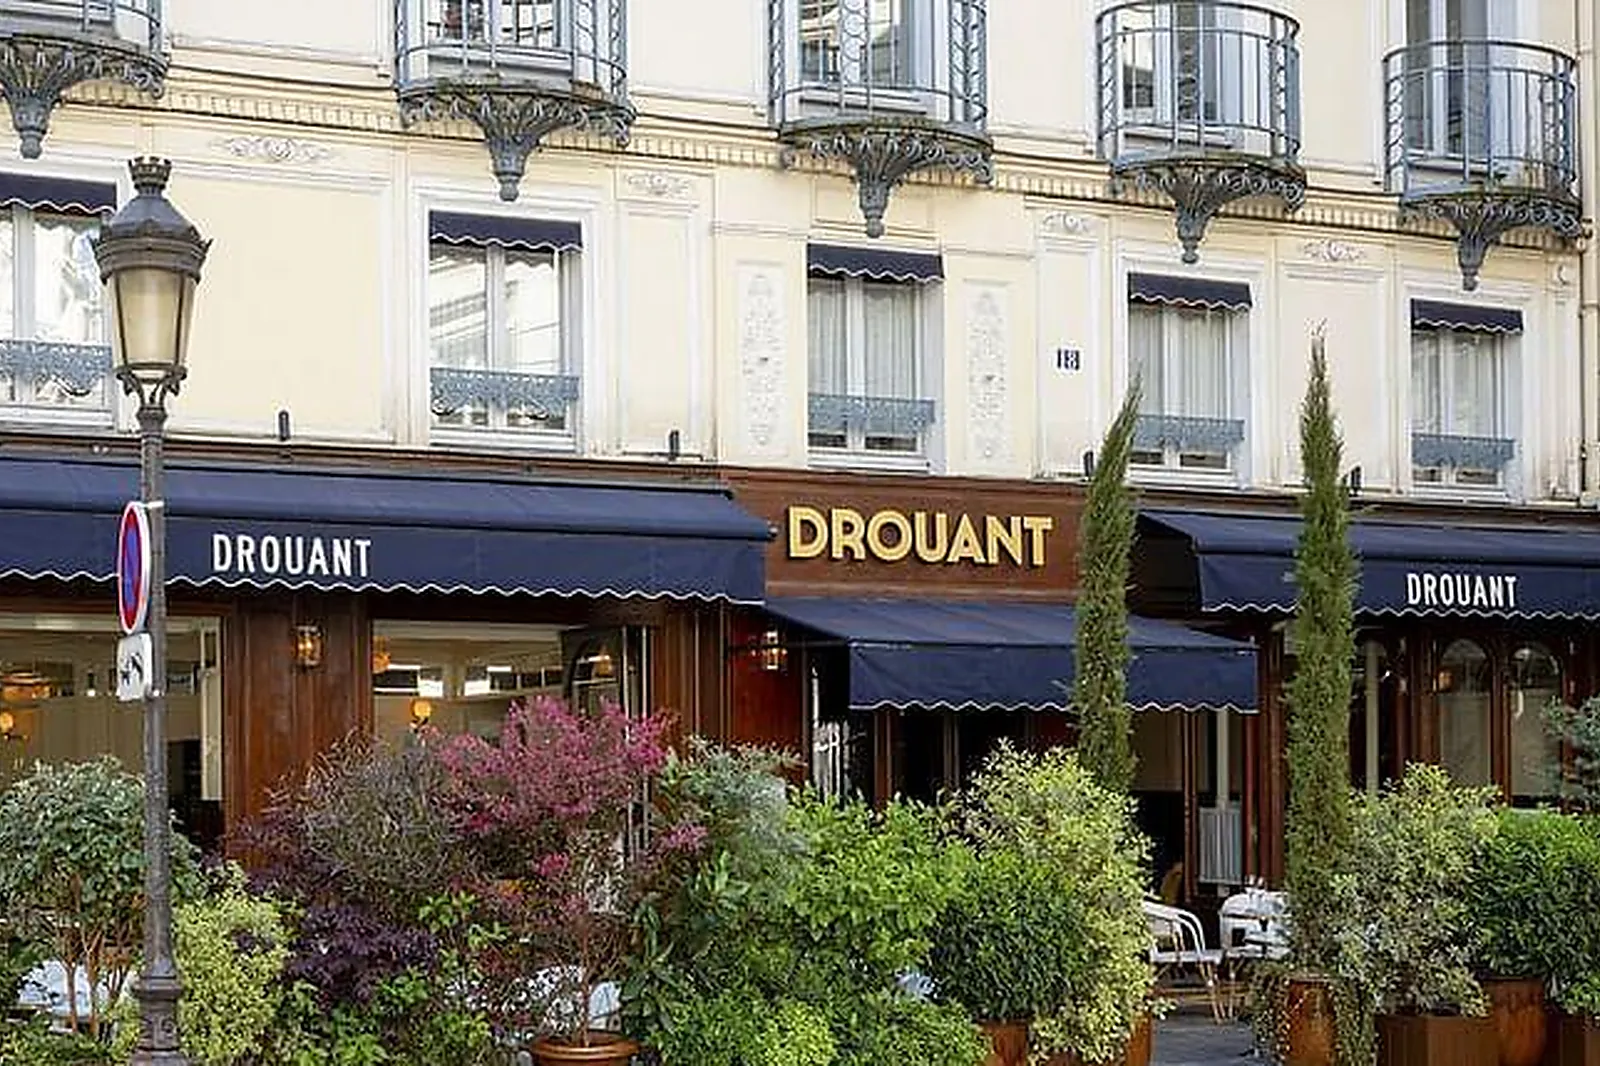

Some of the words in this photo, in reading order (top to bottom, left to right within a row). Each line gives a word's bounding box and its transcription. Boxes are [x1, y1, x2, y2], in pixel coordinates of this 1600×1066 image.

[212, 533, 371, 577] DROUANT
[788, 506, 1053, 566] DROUANT
[1406, 573, 1517, 608] DROUANT
